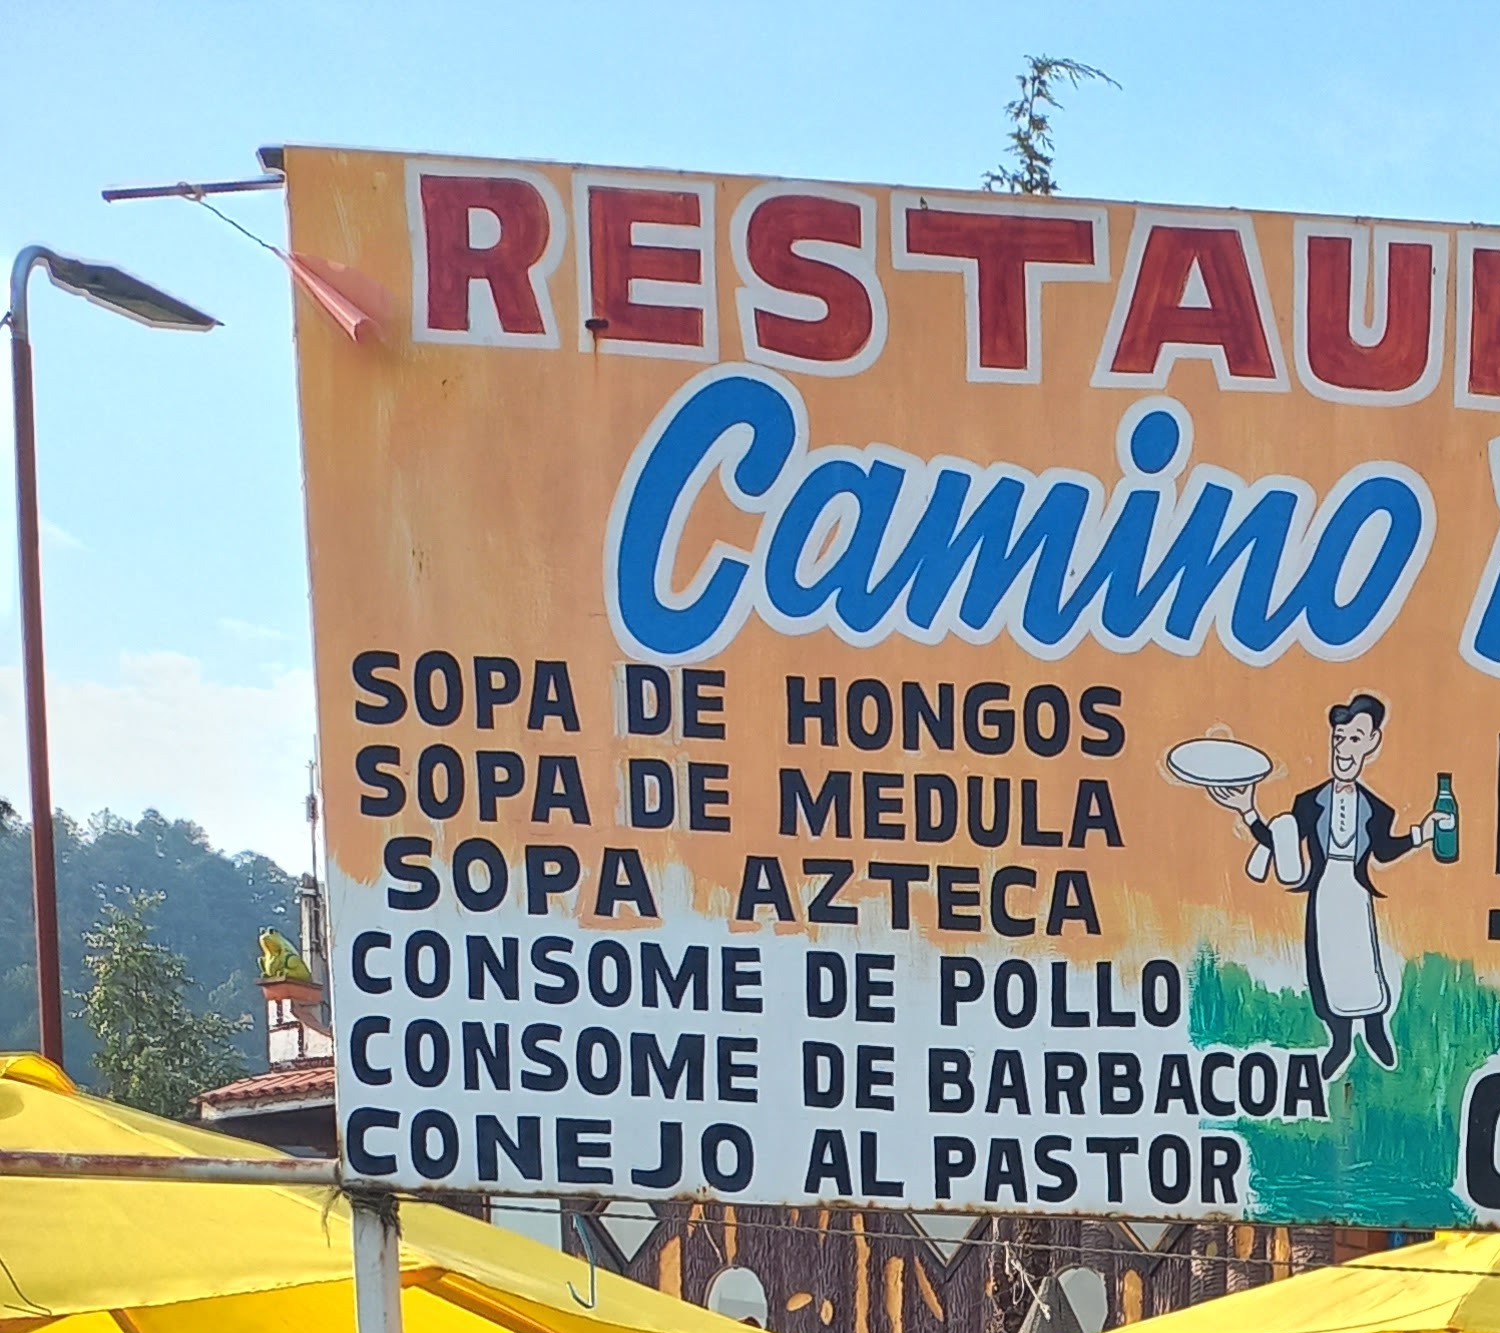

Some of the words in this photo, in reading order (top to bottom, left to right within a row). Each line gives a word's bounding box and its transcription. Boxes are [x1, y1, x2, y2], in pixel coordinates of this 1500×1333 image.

[614, 371, 1426, 658] Camino
[352, 652, 579, 733] SOPA
[625, 662, 727, 740] DE
[786, 675, 1125, 759] HONGOS
[357, 744, 591, 827] SOPA
[629, 758, 732, 833] DE
[778, 766, 1124, 848] MEDULA
[382, 836, 657, 919] SOPA
[737, 855, 1101, 936] AZTECA
[350, 930, 764, 1014] CONSOME
[805, 949, 895, 1024] DE
[939, 955, 1182, 1029] POLLO
[349, 1015, 760, 1104] CONSOME
[803, 1038, 897, 1112] DE
[927, 1047, 1328, 1118] BARBACOA
[345, 1107, 756, 1194] CONEJO
[804, 1127, 903, 1198] AL
[932, 1133, 1243, 1206] PASTOR
